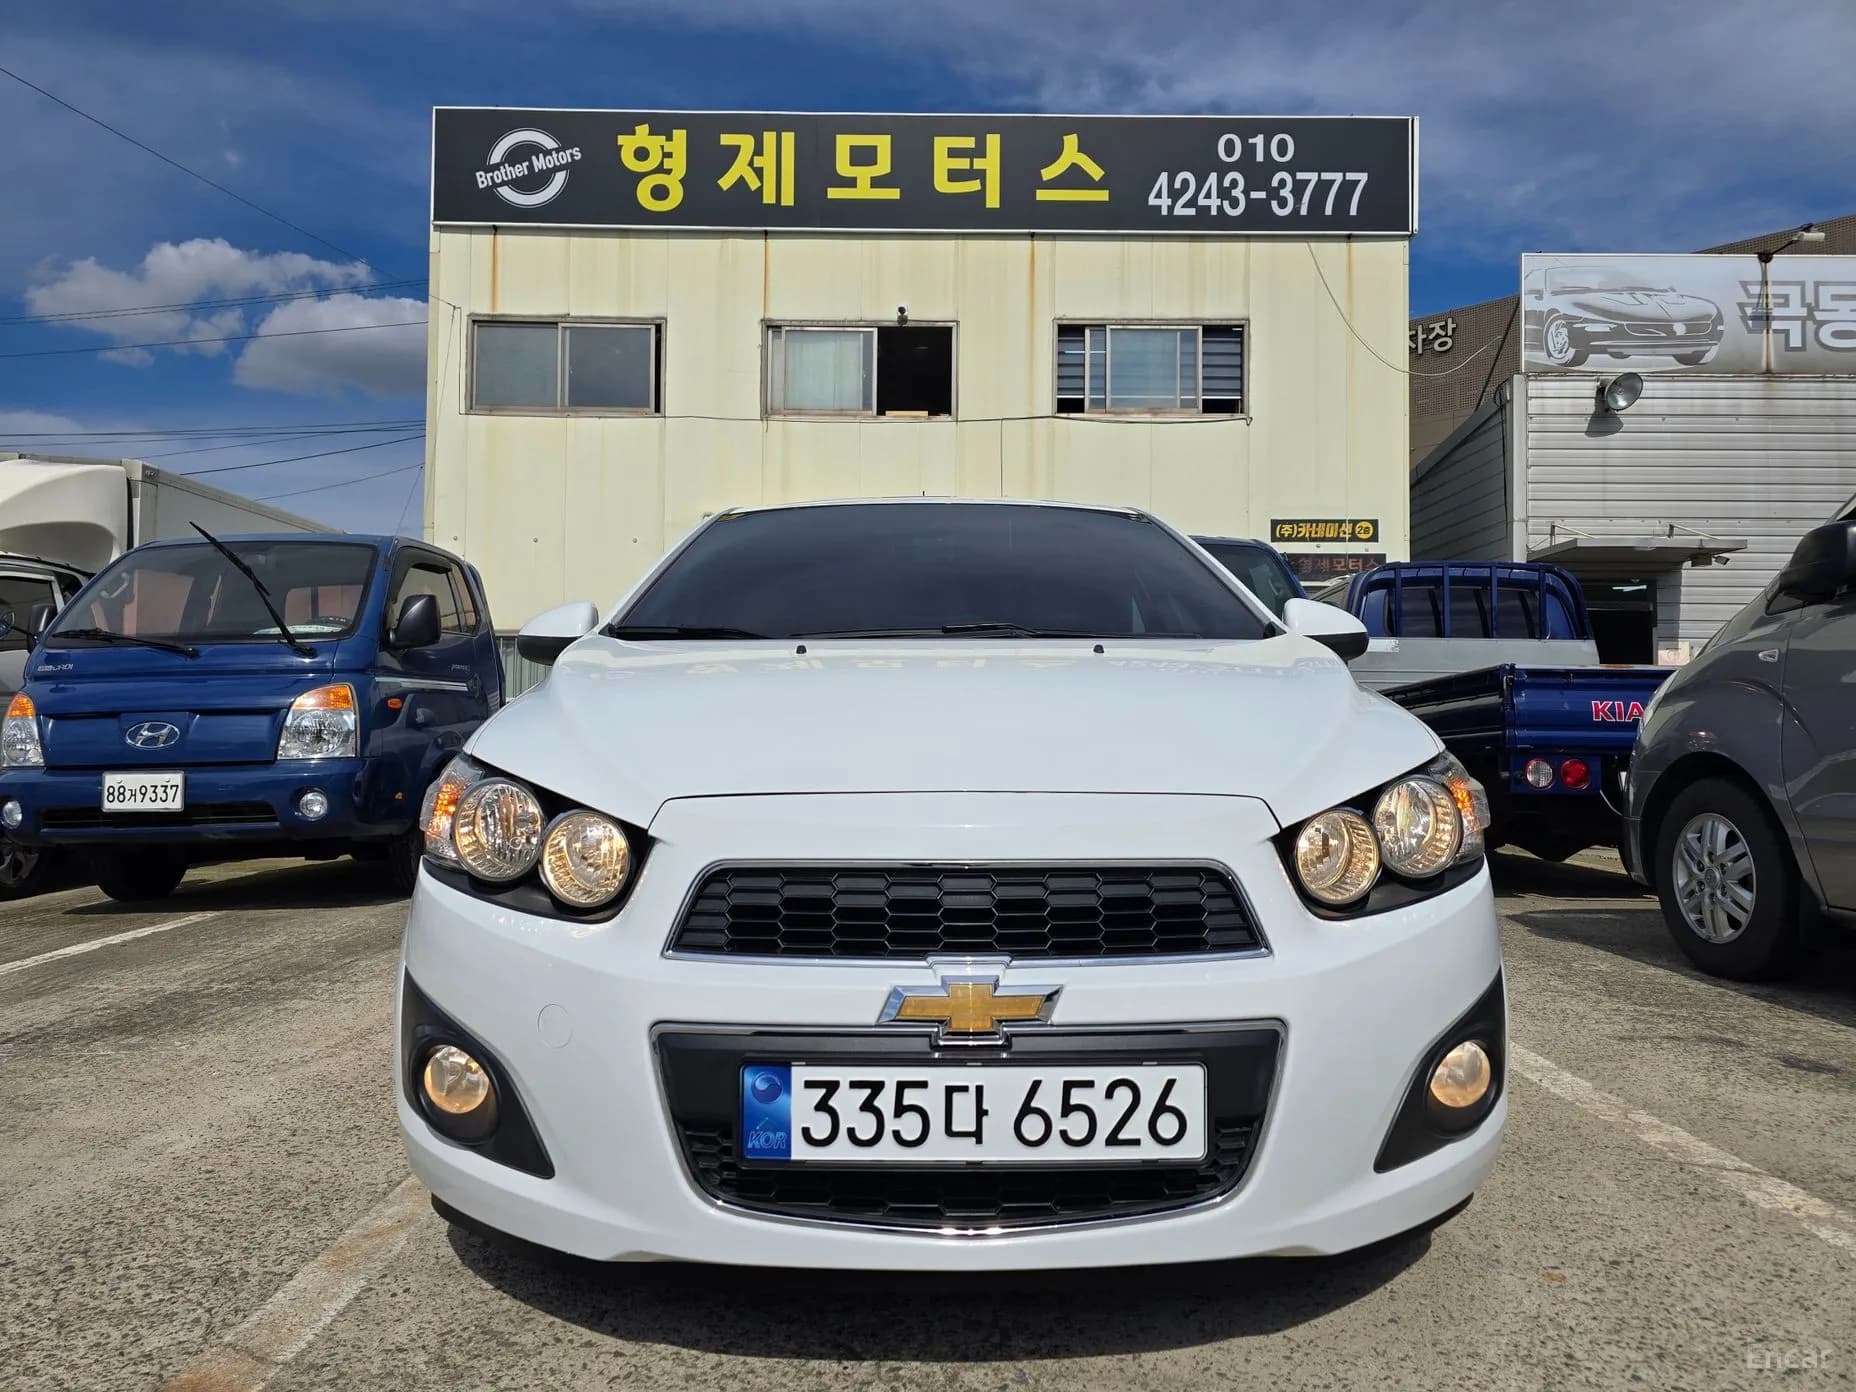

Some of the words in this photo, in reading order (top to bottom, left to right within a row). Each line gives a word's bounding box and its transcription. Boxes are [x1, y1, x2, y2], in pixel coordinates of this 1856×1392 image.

[1217, 133, 1295, 163] 010
[475, 161, 530, 189] Brother
[531, 146, 582, 172] Motors
[617, 123, 1110, 212] 형제모터스
[1148, 172, 1369, 216] 4243-3777
[1592, 701, 1645, 722] KIA
[106, 785, 179, 803] 88거9337
[801, 1079, 989, 1148] 335다
[1013, 1078, 1188, 1147] 6526
[747, 1131, 787, 1149] KOR
